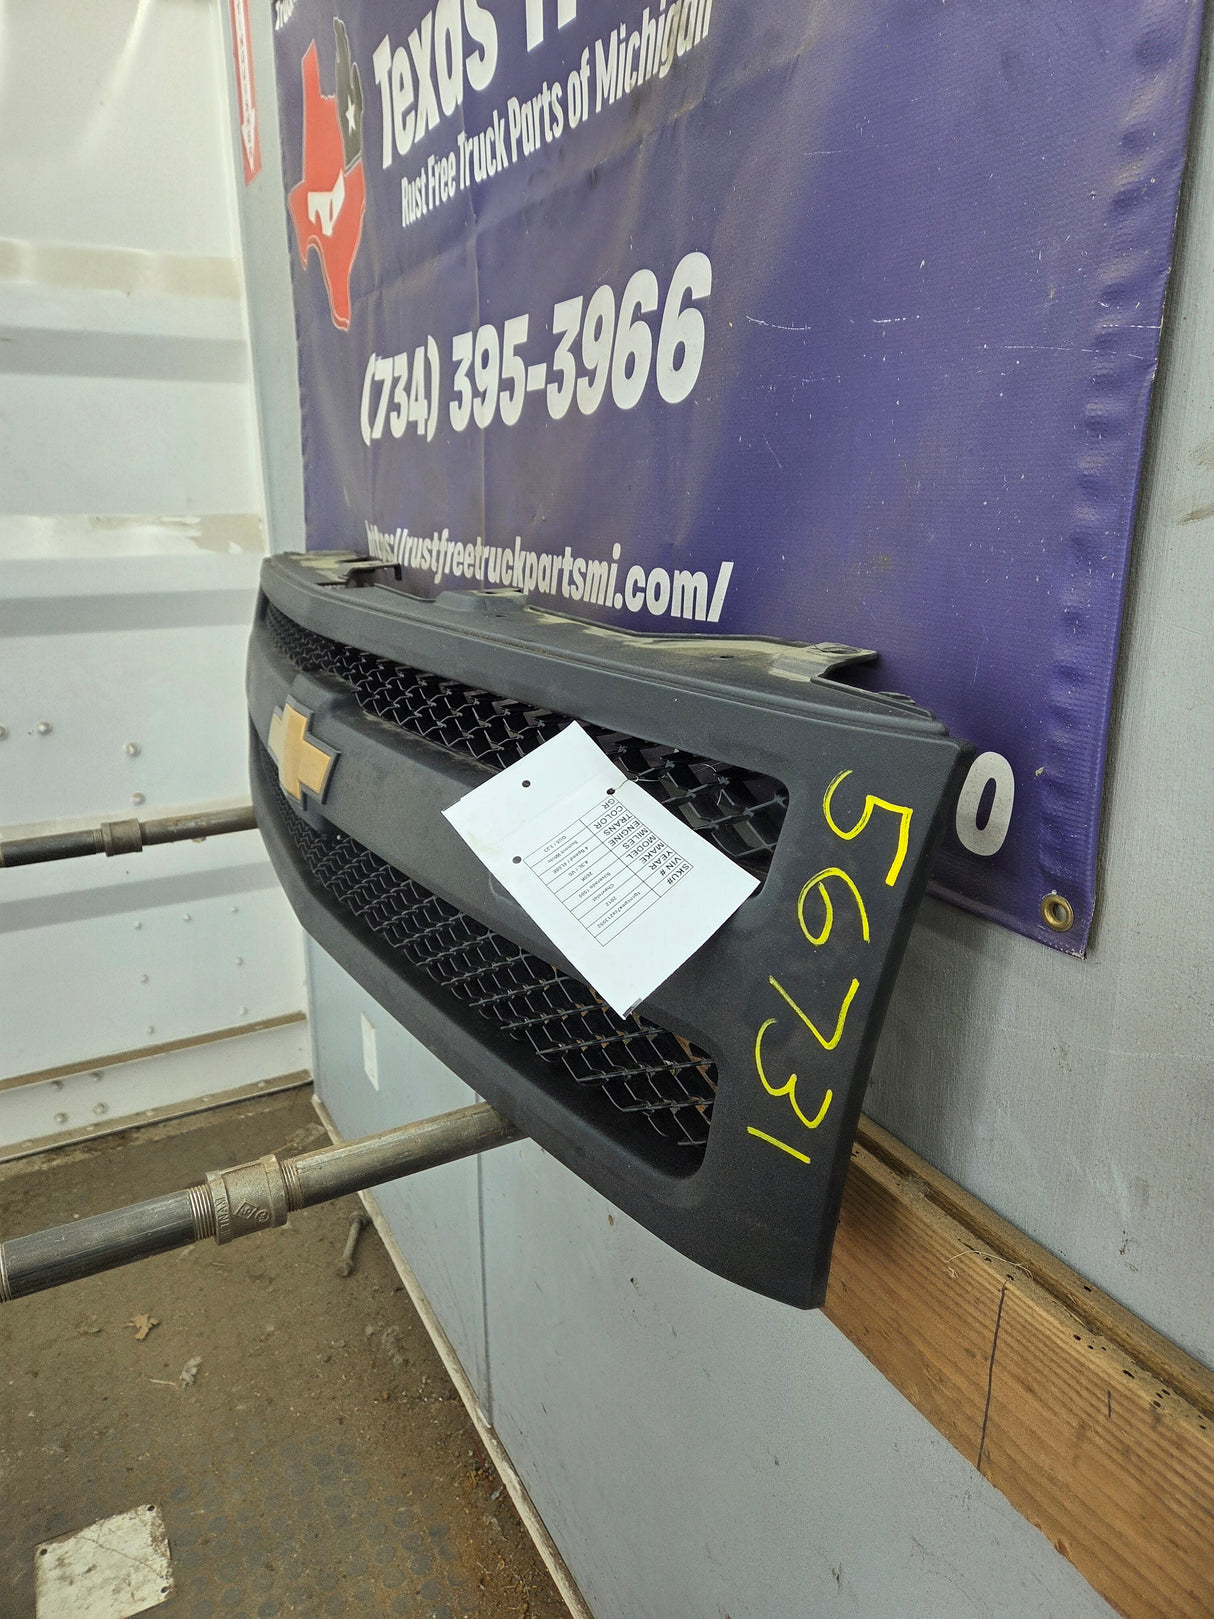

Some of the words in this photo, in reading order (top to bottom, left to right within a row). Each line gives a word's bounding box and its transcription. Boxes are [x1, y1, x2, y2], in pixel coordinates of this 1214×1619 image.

[372, 0, 498, 170] Texas
[401, 167, 427, 228] Rust
[428, 151, 456, 210] Free
[457, 110, 509, 190] Truck
[507, 81, 564, 164] Parts
[567, 47, 590, 129] of
[595, 0, 712, 113] Michigan
[360, 335, 440, 447] (734)
[449, 252, 712, 432] 395-3966
[601, 798, 616, 810] GR
[593, 805, 624, 830] COLOR
[603, 813, 633, 836] TRANS
[607, 820, 641, 847] ENGINE
[622, 827, 649, 850] MILES
[547, 852, 562, 863] White
[560, 839, 579, 855] Summit
[569, 848, 586, 862] Speed
[625, 834, 657, 859] MODEL
[639, 842, 665, 864] MAKE
[648, 850, 673, 871] YEAR
[665, 857, 682, 871] VIN
[589, 871, 612, 889] Silverado
[666, 863, 690, 885] SKU#
[578, 888, 590, 899] 1500
[592, 883, 615, 902] Chevrolet
[605, 895, 618, 907] 2012
[746, 770, 914, 1164] 56731
